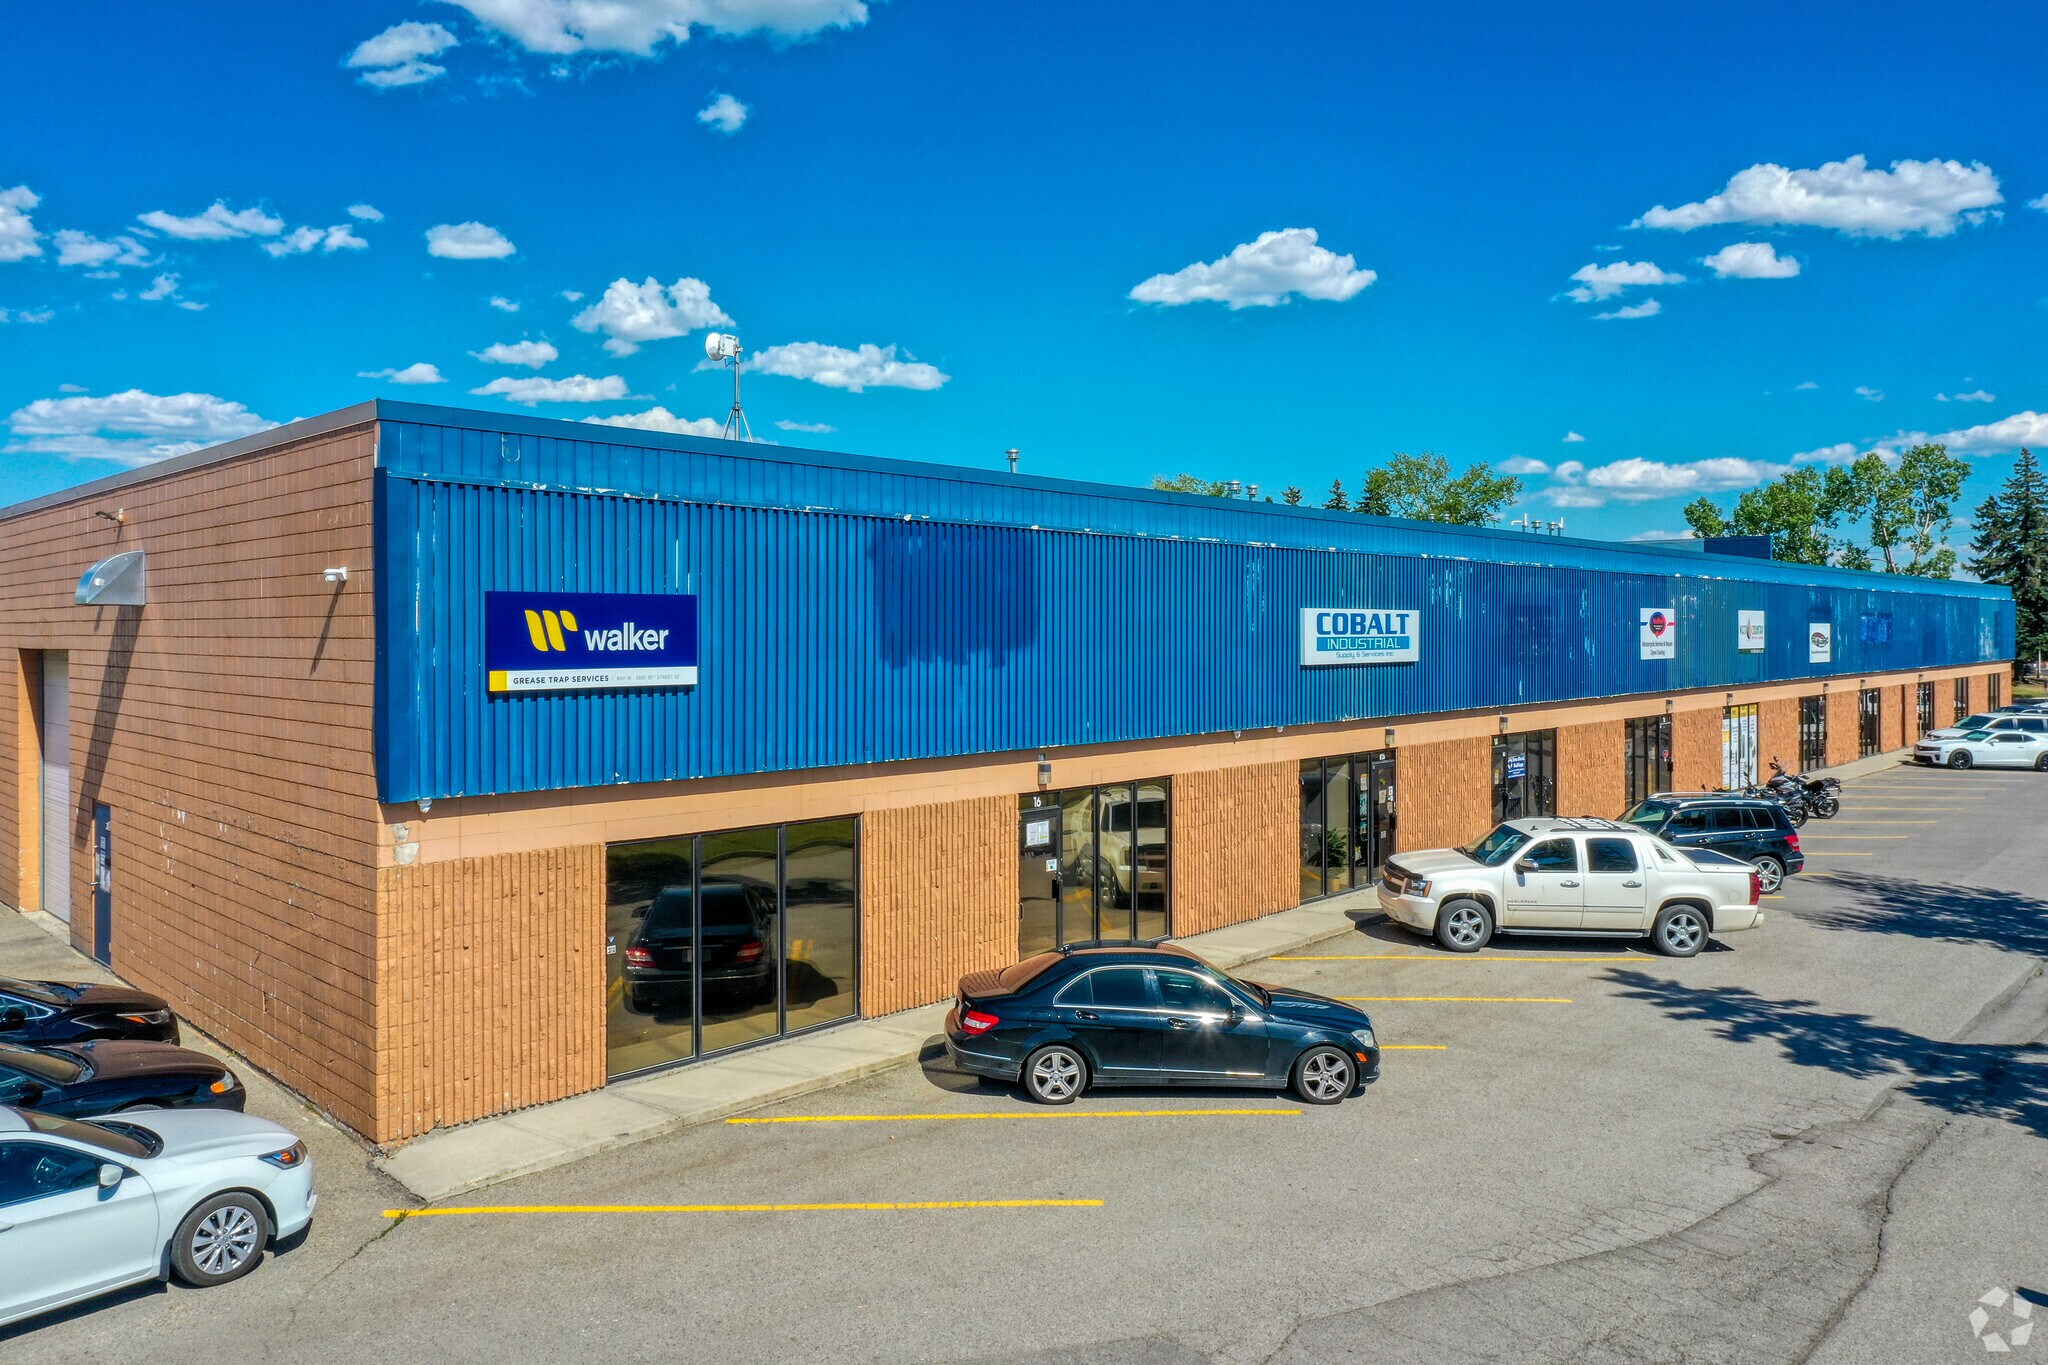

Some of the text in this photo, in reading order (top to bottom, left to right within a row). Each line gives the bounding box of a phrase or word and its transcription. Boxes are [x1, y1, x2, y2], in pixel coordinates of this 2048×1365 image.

[1316, 612, 1410, 636] COBALT
[584, 622, 669, 652] walker
[1327, 637, 1401, 650] INDUSTRIAL
[1335, 651, 1355, 660] Supply
[513, 674, 609, 685] GREASE TRAP SERVICES
[1033, 796, 1042, 808] 16
